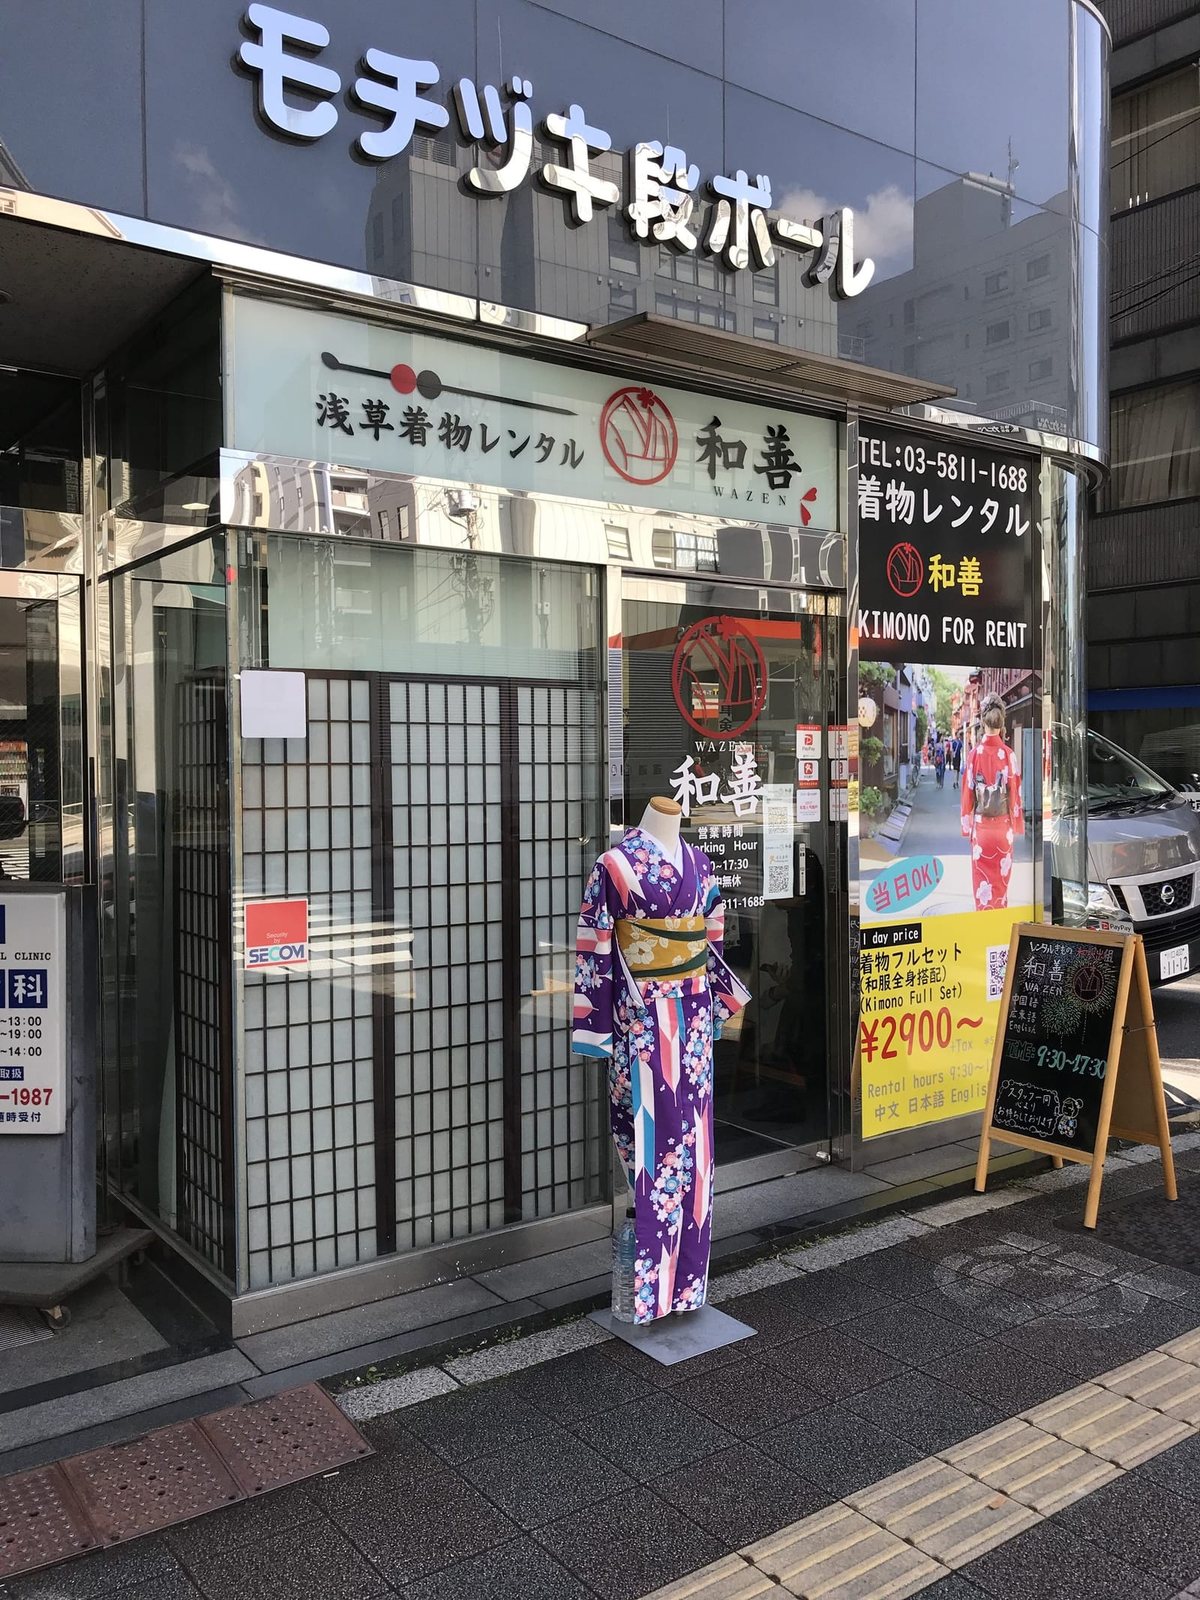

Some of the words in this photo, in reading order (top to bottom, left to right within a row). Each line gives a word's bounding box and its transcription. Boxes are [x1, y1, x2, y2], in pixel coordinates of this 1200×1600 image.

[238, 3, 875, 298] モチヅキ段ボール
[315, 392, 584, 469] 浅草着物レンタル
[696, 416, 802, 491] 和善
[859, 437, 1028, 493] TEL:03-5811-1688
[713, 487, 788, 506] WAZEN
[858, 474, 1030, 536] 着物レンタル
[928, 554, 983, 596] 和善
[859, 610, 930, 642] KIMONO
[942, 617, 975, 645] FOR
[986, 621, 1028, 648] RENT
[669, 754, 766, 818] 和善
[698, 824, 744, 840] 営業時間
[733, 841, 758, 851] Hour
[872, 930, 889, 945] day
[893, 928, 919, 943] price
[1110, 923, 1132, 933] PayPay
[14, 952, 51, 961] CLINIC
[249, 944, 305, 963] SECOM
[860, 942, 962, 975] 着物フルセット
[1030, 941, 1073, 956] レンタルきもの
[910, 988, 933, 1005] Full
[940, 982, 962, 1000] Set)
[1009, 1020, 1036, 1034] English
[868, 1076, 906, 1098] Rental
[914, 1071, 944, 1089] hours
[875, 1101, 900, 1121] 中文
[909, 1091, 945, 1114] 日本語
